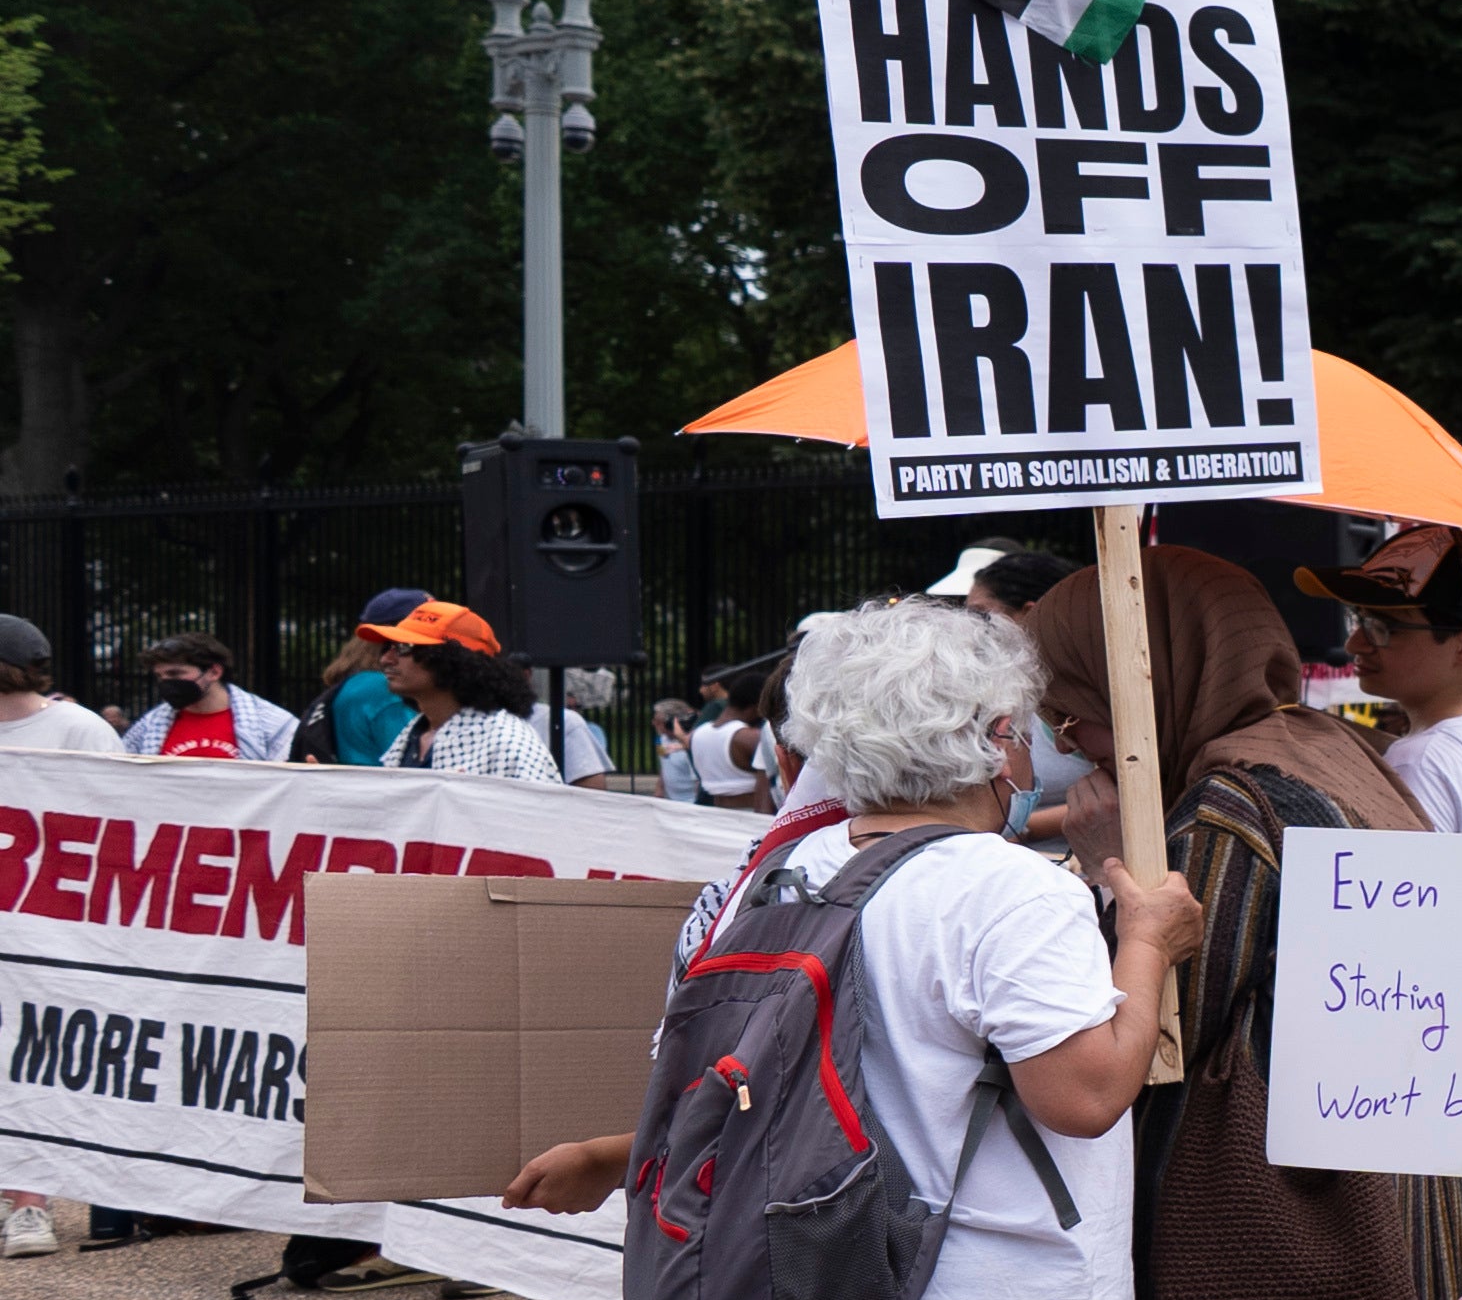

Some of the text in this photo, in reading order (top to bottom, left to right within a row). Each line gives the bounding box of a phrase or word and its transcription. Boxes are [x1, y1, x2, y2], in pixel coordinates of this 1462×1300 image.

[860, 133, 1272, 236] OFF
[874, 262, 1295, 438] IRAN!
[899, 449, 1297, 492] PARTY FOR SOCIALISM & LIBERATION
[1333, 851, 1438, 910] Even
[1324, 963, 1449, 1052] Starting
[9, 1002, 166, 1103] MORE
[1317, 1075, 1421, 1120] Won't
